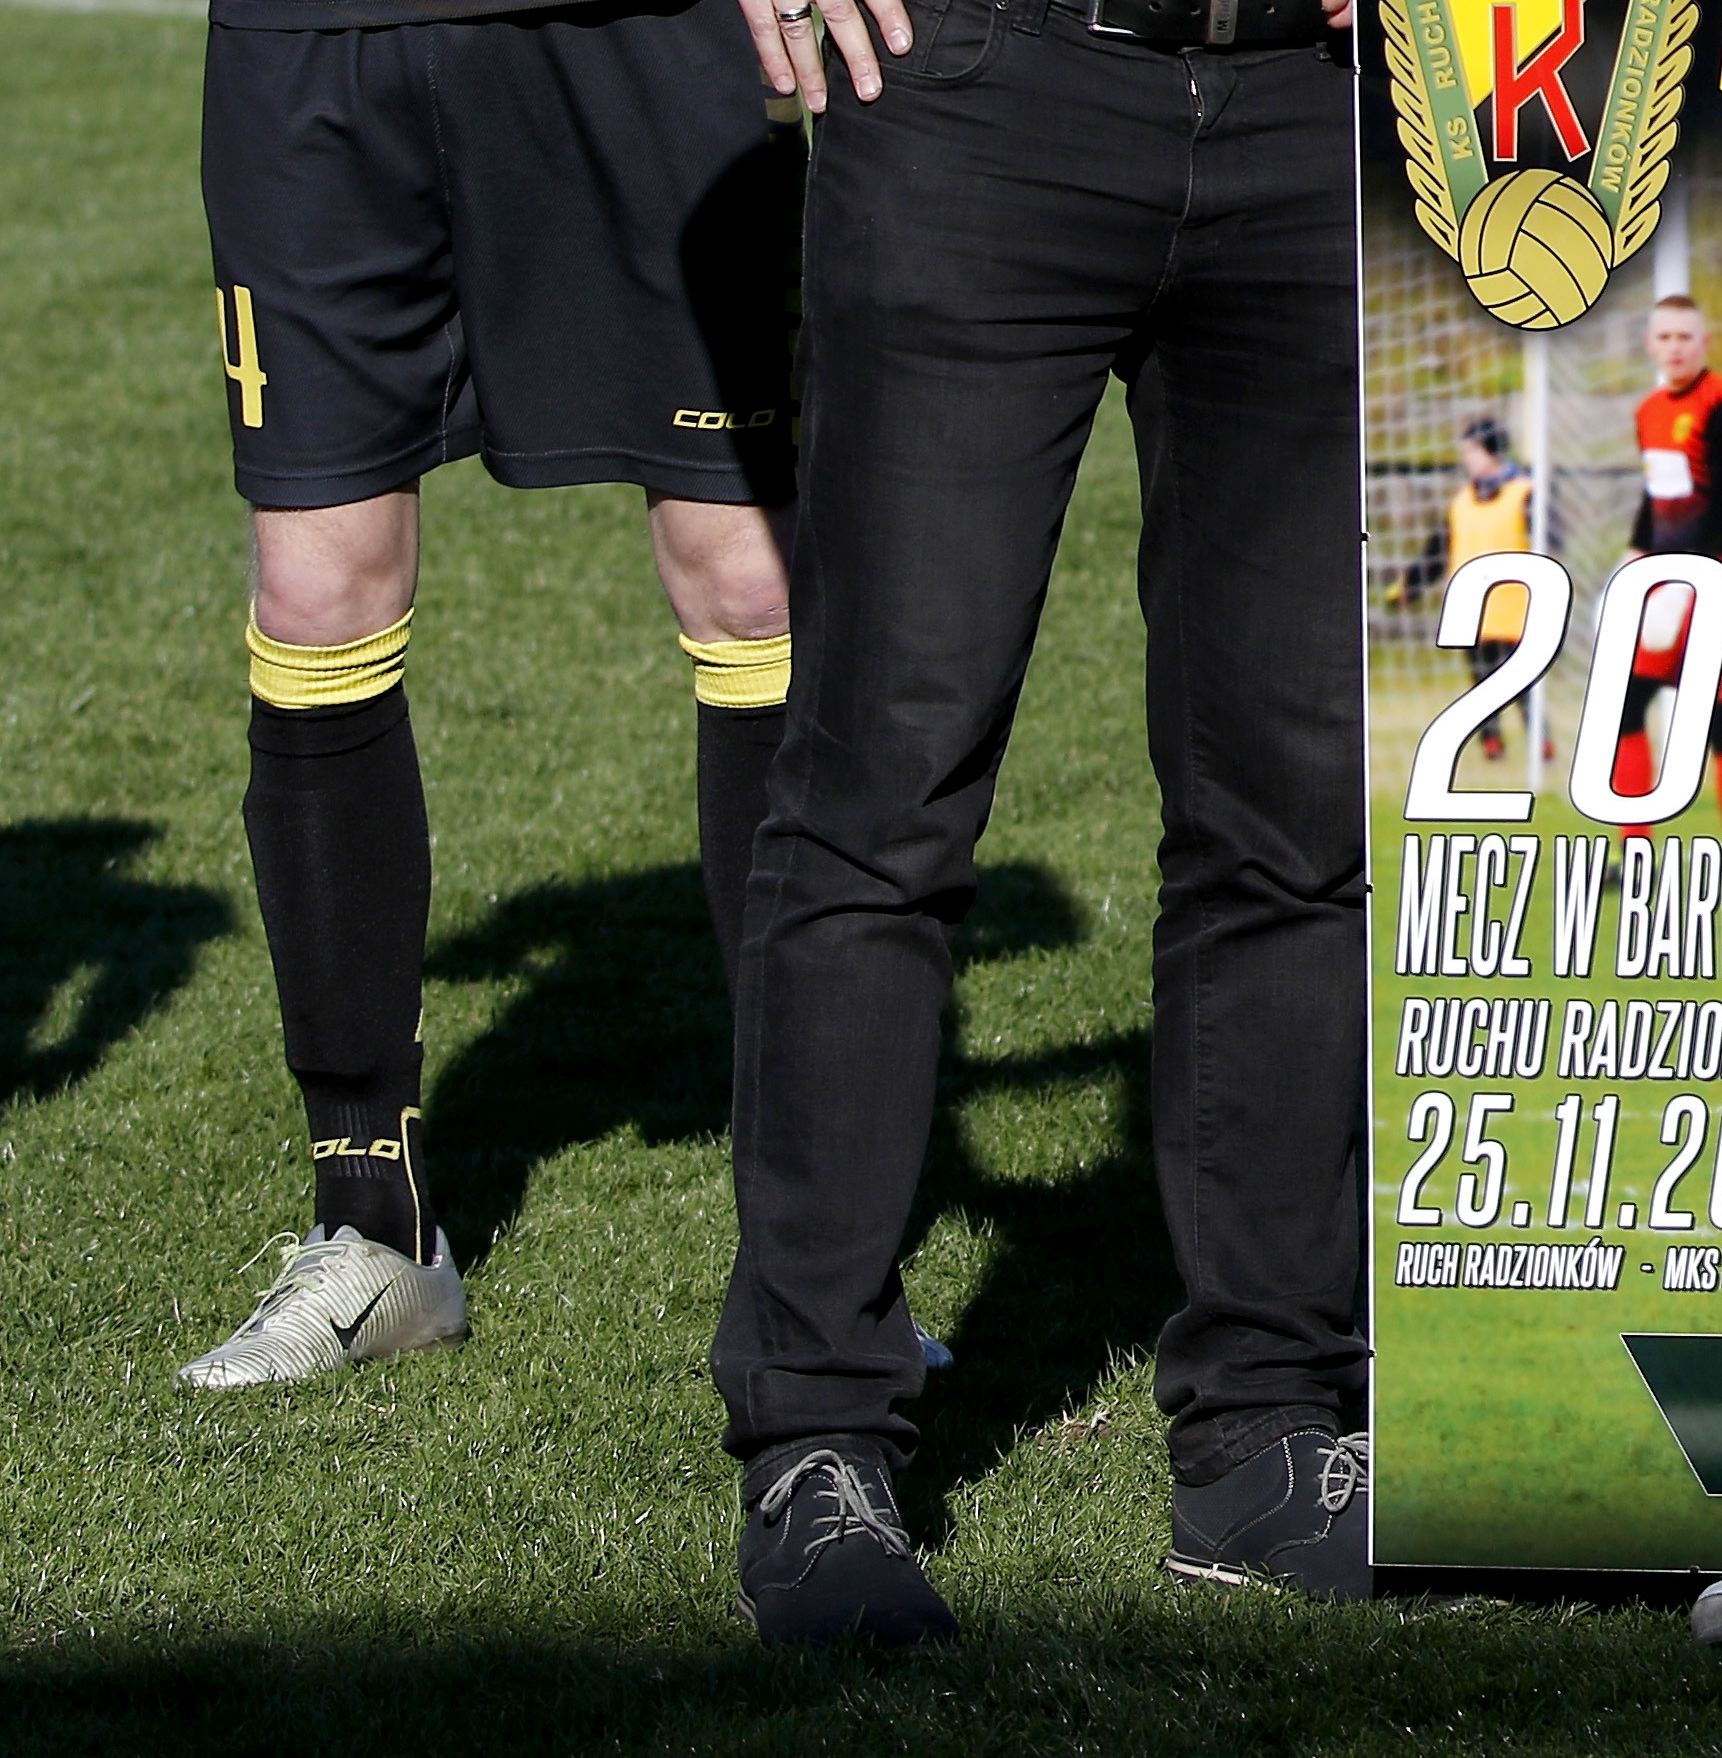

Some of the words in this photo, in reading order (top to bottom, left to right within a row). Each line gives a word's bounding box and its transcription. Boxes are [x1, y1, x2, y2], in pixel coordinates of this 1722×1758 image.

[1418, 0, 1459, 90] RUCH
[1445, 115, 1473, 160] KS
[213, 285, 267, 428] 4
[673, 409, 775, 430] COLO
[1396, 835, 1539, 978] MECZ
[1553, 836, 1609, 979] W
[1396, 997, 1551, 1078] RUCHU
[311, 1136, 401, 1161] OLO
[1396, 1243, 1459, 1288] RUCH
[1463, 1237, 1624, 1290] RADZIONKÓW
[1663, 1246, 1719, 1292] MKS
